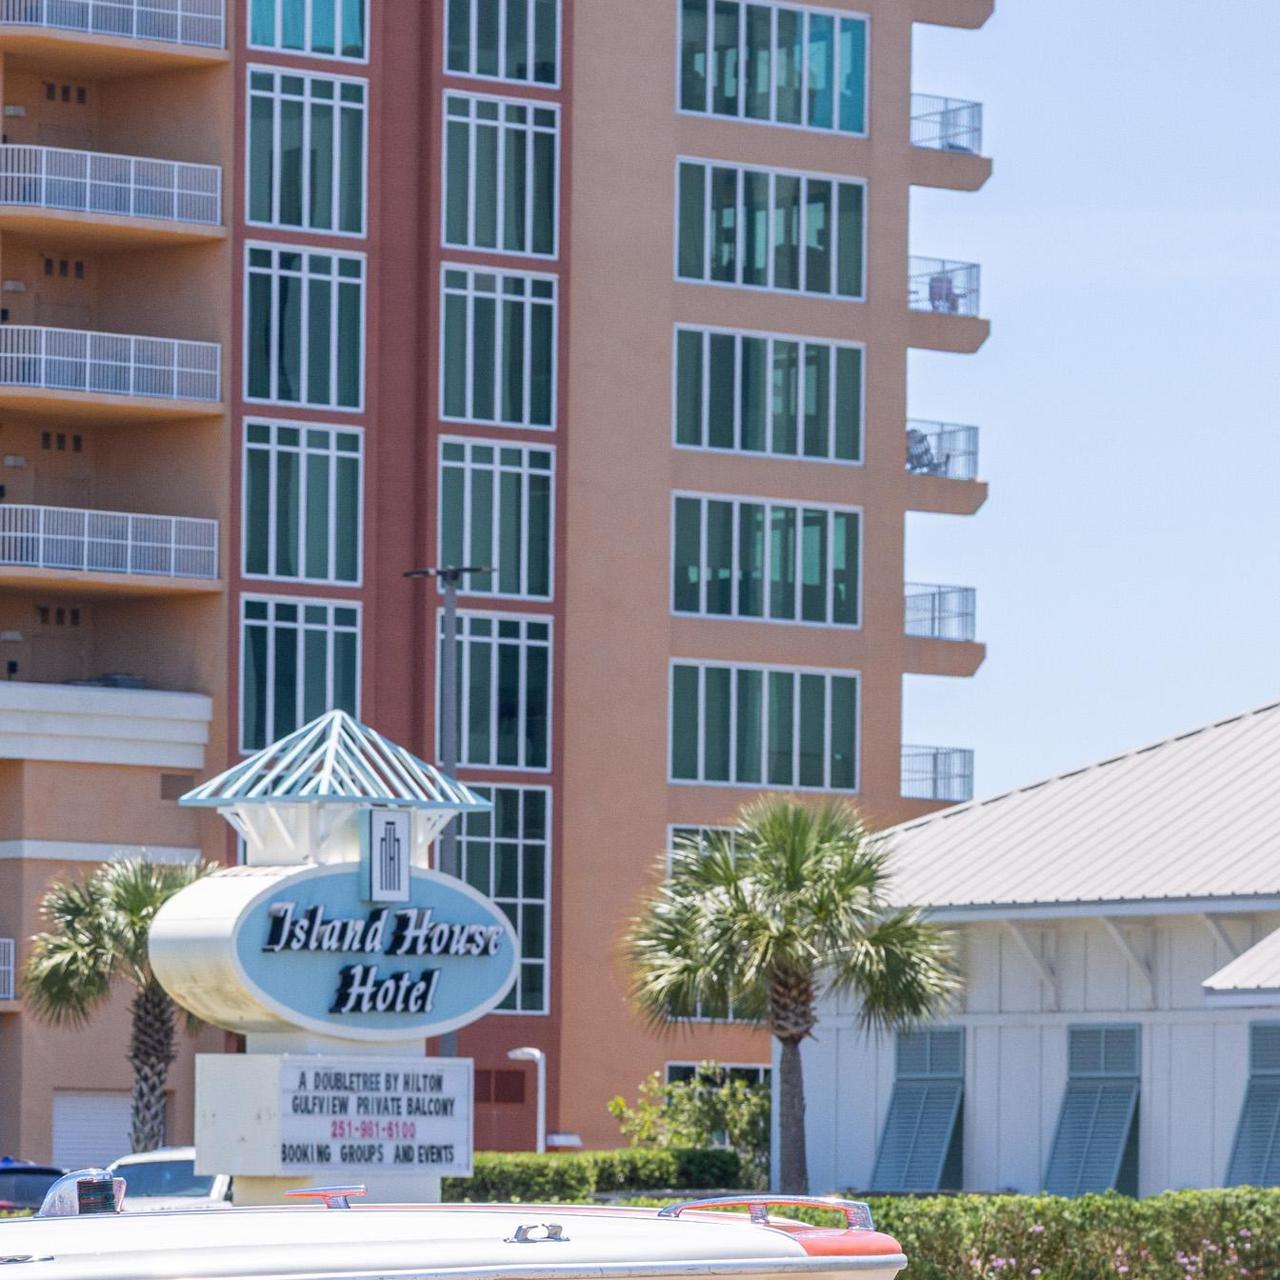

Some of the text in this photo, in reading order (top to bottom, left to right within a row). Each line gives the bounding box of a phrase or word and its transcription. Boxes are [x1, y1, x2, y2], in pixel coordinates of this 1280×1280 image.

[263, 902, 504, 956] Island House
[333, 963, 440, 1014] Hotel
[298, 1071, 444, 1093] A DOUBLETREE BY HILTON
[291, 1095, 456, 1117] GULFVIEW PRIVATE BALCONY
[281, 1143, 454, 1164] BOOKING GROUPS AND EVENTS
